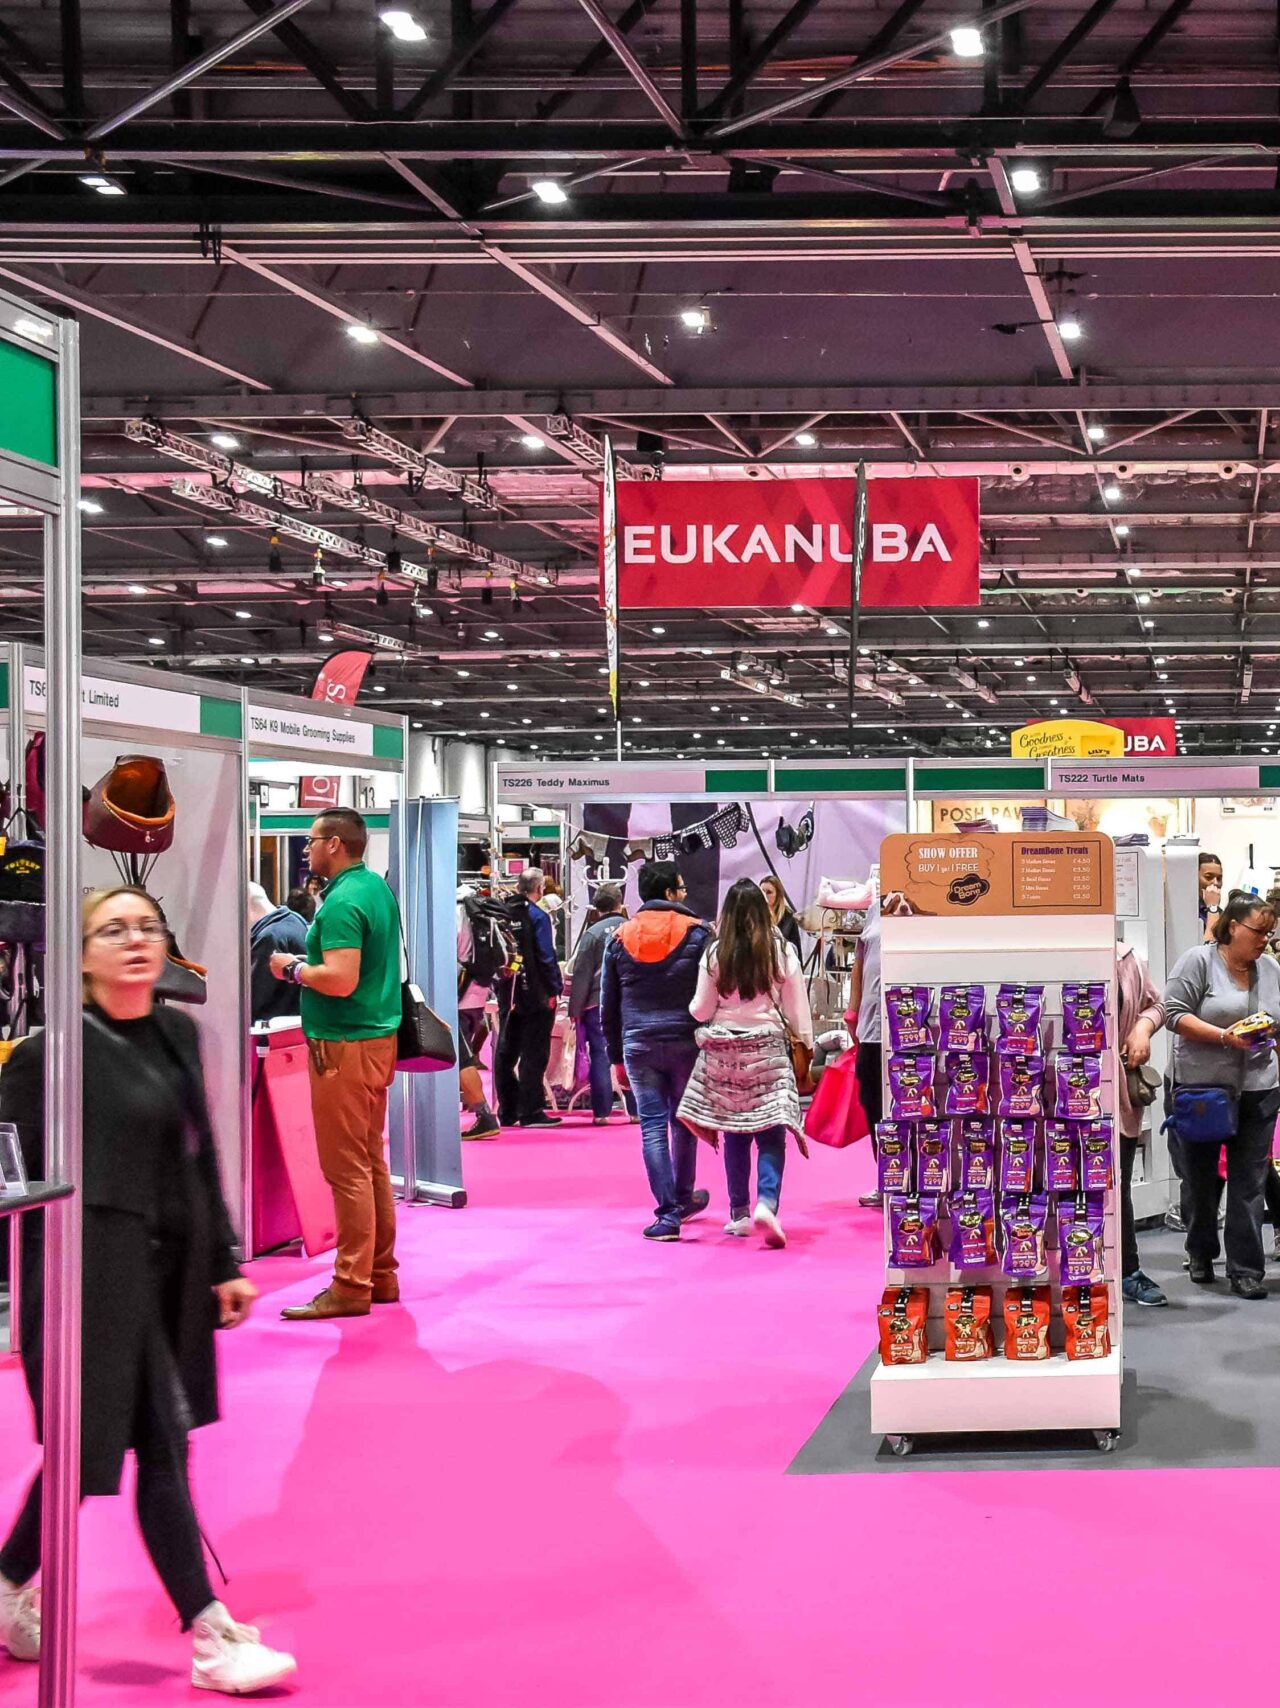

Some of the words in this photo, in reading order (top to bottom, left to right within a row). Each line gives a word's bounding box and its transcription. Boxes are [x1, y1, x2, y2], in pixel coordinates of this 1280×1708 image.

[88, 692, 120, 708] Limited
[250, 717, 268, 732] TS64
[270, 720, 278, 733] K9
[280, 722, 301, 737] Mobile
[302, 725, 331, 743] Grooming
[332, 729, 356, 744] Supplies
[1019, 733, 1064, 749] Goodness
[502, 777, 532, 788] TS226
[536, 777, 564, 789] Teddy
[568, 777, 610, 788] Maximus
[1059, 774, 1089, 783] TS222
[1092, 774, 1118, 783] Turtle
[1122, 774, 1145, 783] Mats
[919, 847, 946, 860] SHOW
[949, 847, 978, 860] OFFER
[1021, 847, 1064, 855] DreamBone
[1066, 846, 1089, 855] Treats
[918, 864, 937, 873] BUY
[955, 864, 980, 872] FREE
[954, 882, 981, 894] Dream
[959, 889, 981, 899] Bone
